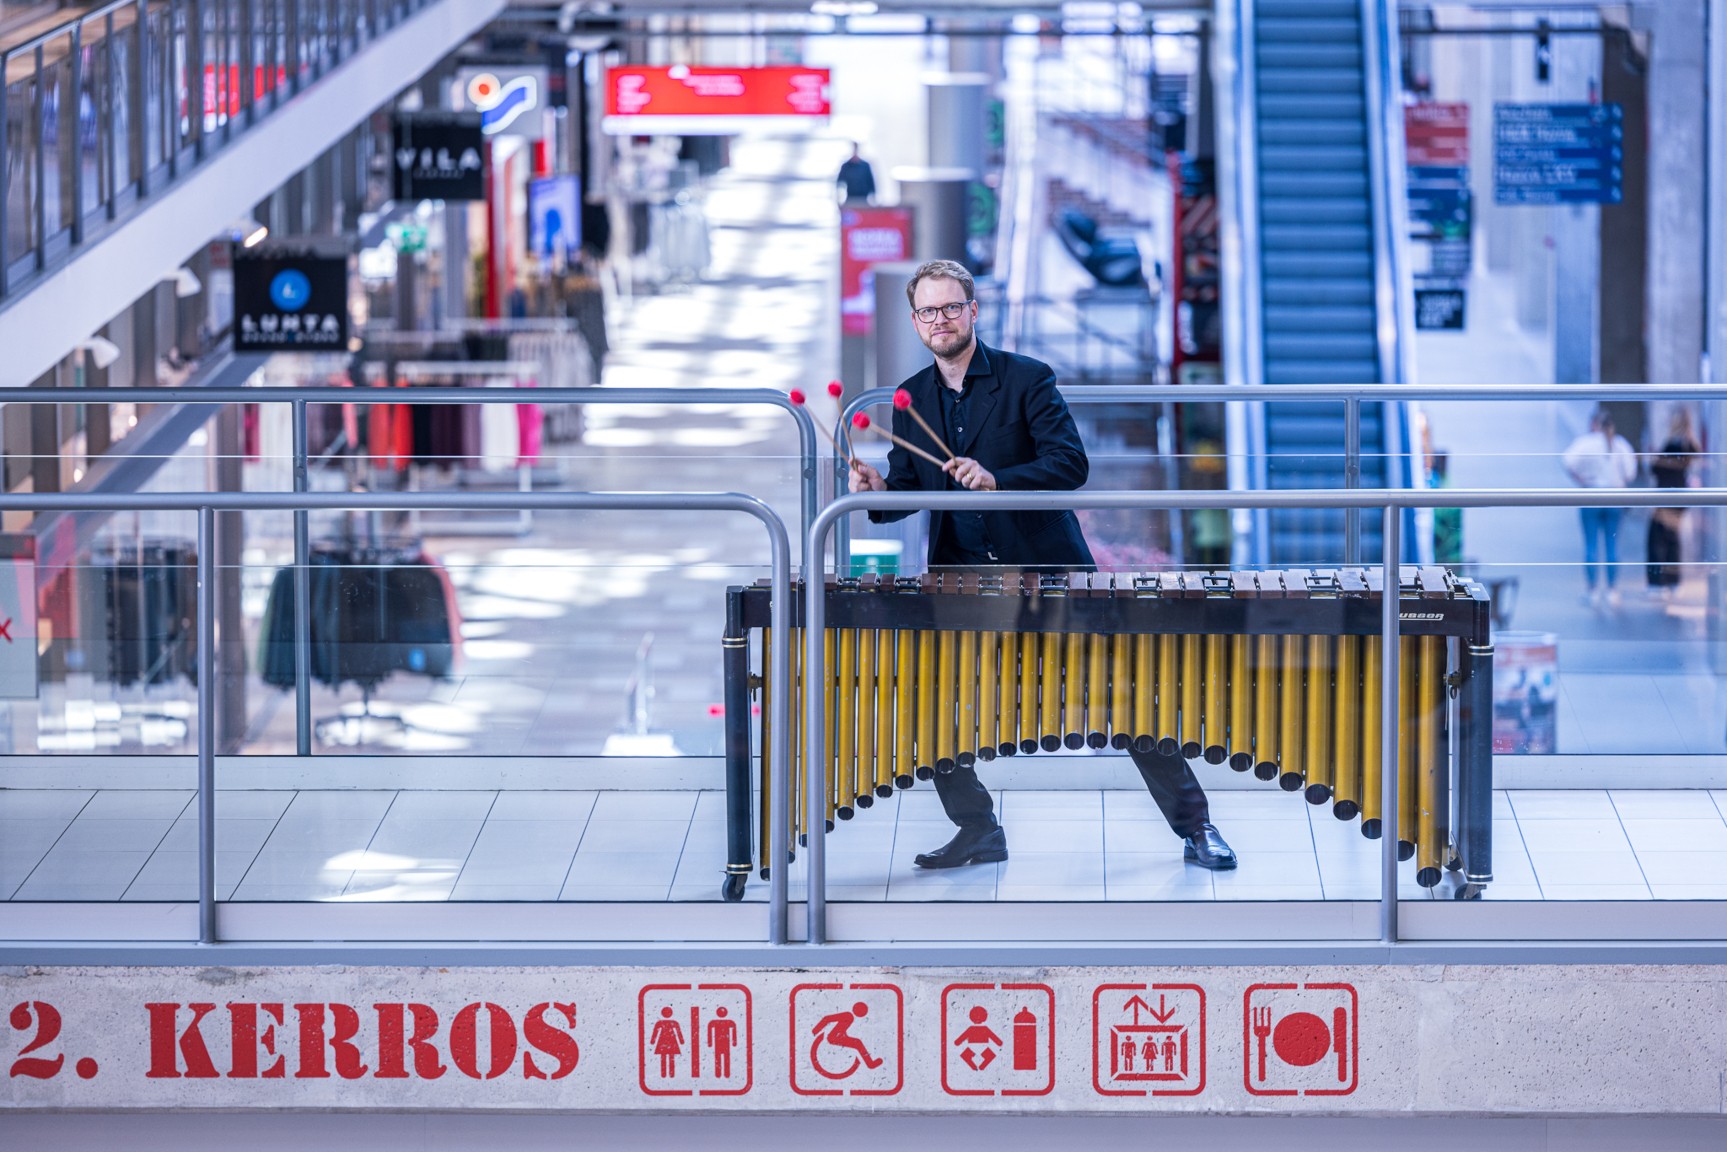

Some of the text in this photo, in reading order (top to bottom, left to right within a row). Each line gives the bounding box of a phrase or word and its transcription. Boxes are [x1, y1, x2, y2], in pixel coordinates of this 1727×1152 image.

[396, 147, 481, 170] VILA
[241, 314, 339, 332] LUHTA
[10, 1001, 579, 1080] 2. KERROS
